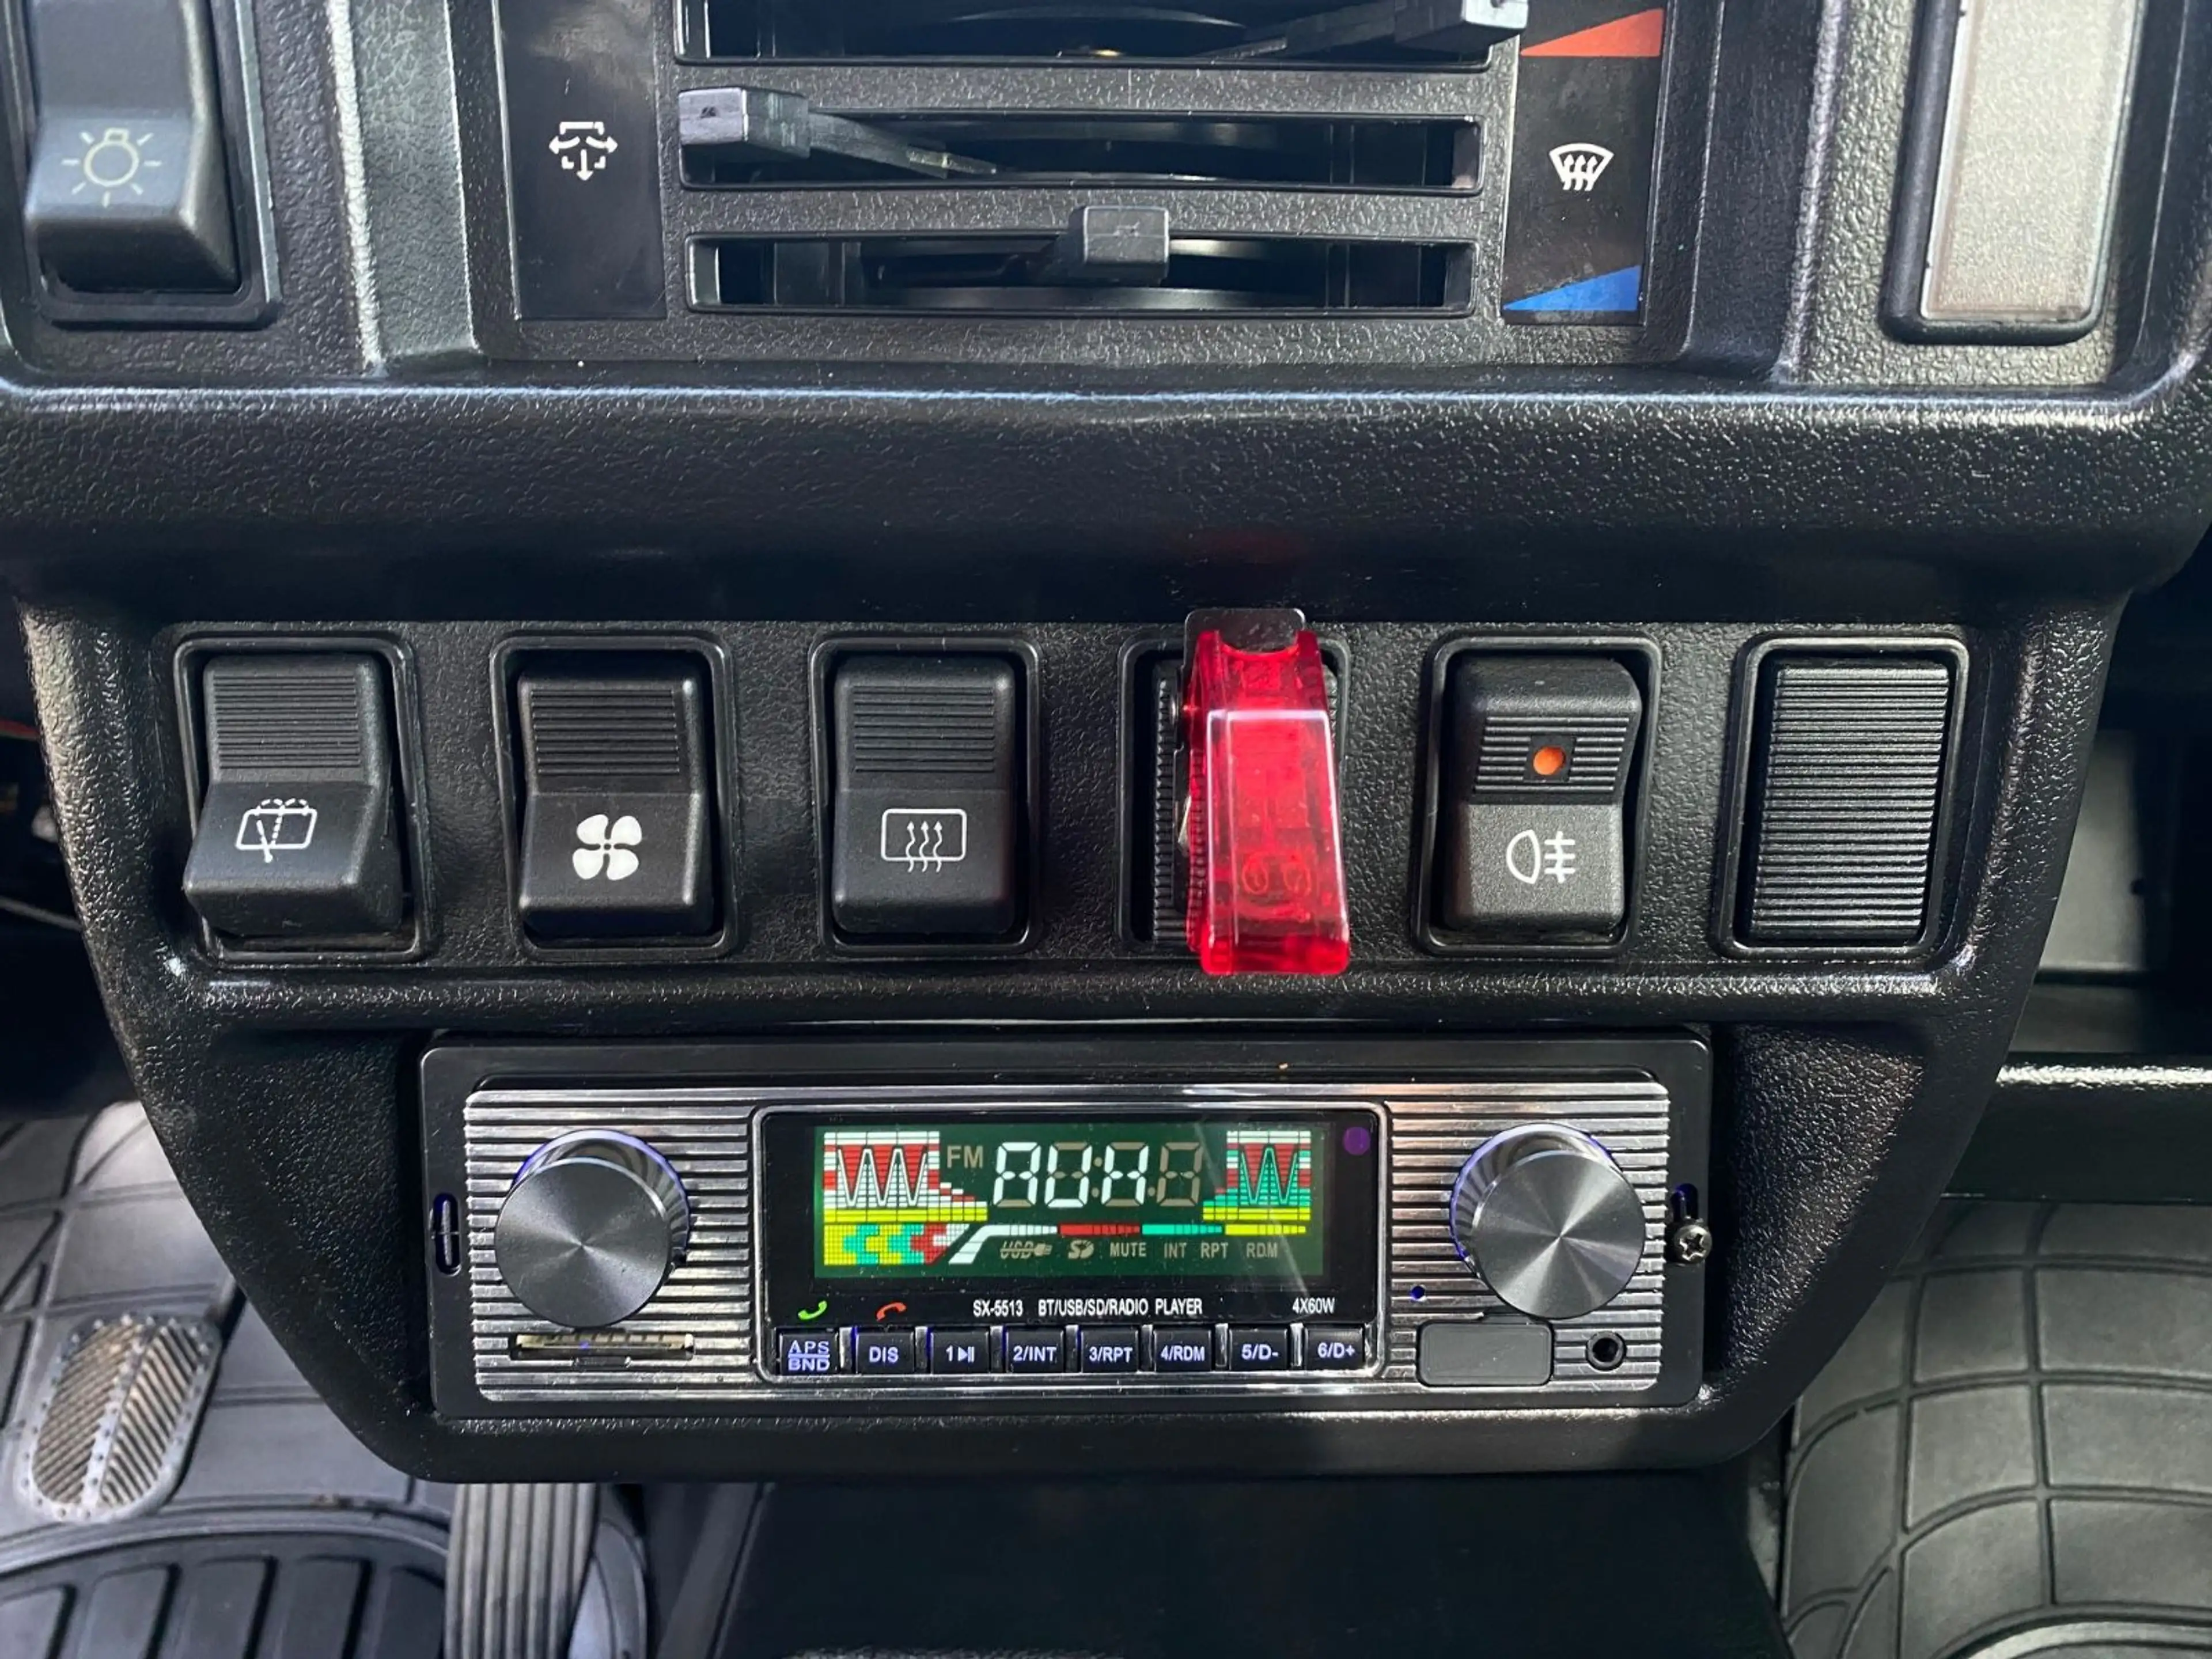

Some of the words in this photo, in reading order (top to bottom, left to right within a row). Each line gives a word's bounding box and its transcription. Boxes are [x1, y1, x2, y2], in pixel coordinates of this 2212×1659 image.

[946, 1145, 983, 1169] FM
[1109, 1241, 1147, 1258] MUTE
[1164, 1242, 1187, 1257] INT
[1200, 1242, 1229, 1257] RPT
[1246, 1241, 1278, 1258] RDM
[973, 1300, 1024, 1317] SX-5513
[1037, 1298, 1148, 1316] BT/USB/SD/RADIO
[1155, 1298, 1203, 1316] PLAYER
[1292, 1297, 1335, 1314] 4X60W
[788, 1340, 830, 1354] APS
[869, 1346, 899, 1363] DIS
[1013, 1346, 1057, 1363] 2/INT
[1089, 1346, 1133, 1362] 3/RPT
[1160, 1346, 1205, 1362] 4/RDM
[1241, 1344, 1279, 1360] 5/D-
[1317, 1342, 1356, 1358] 6/D+
[787, 1357, 831, 1372] BND
